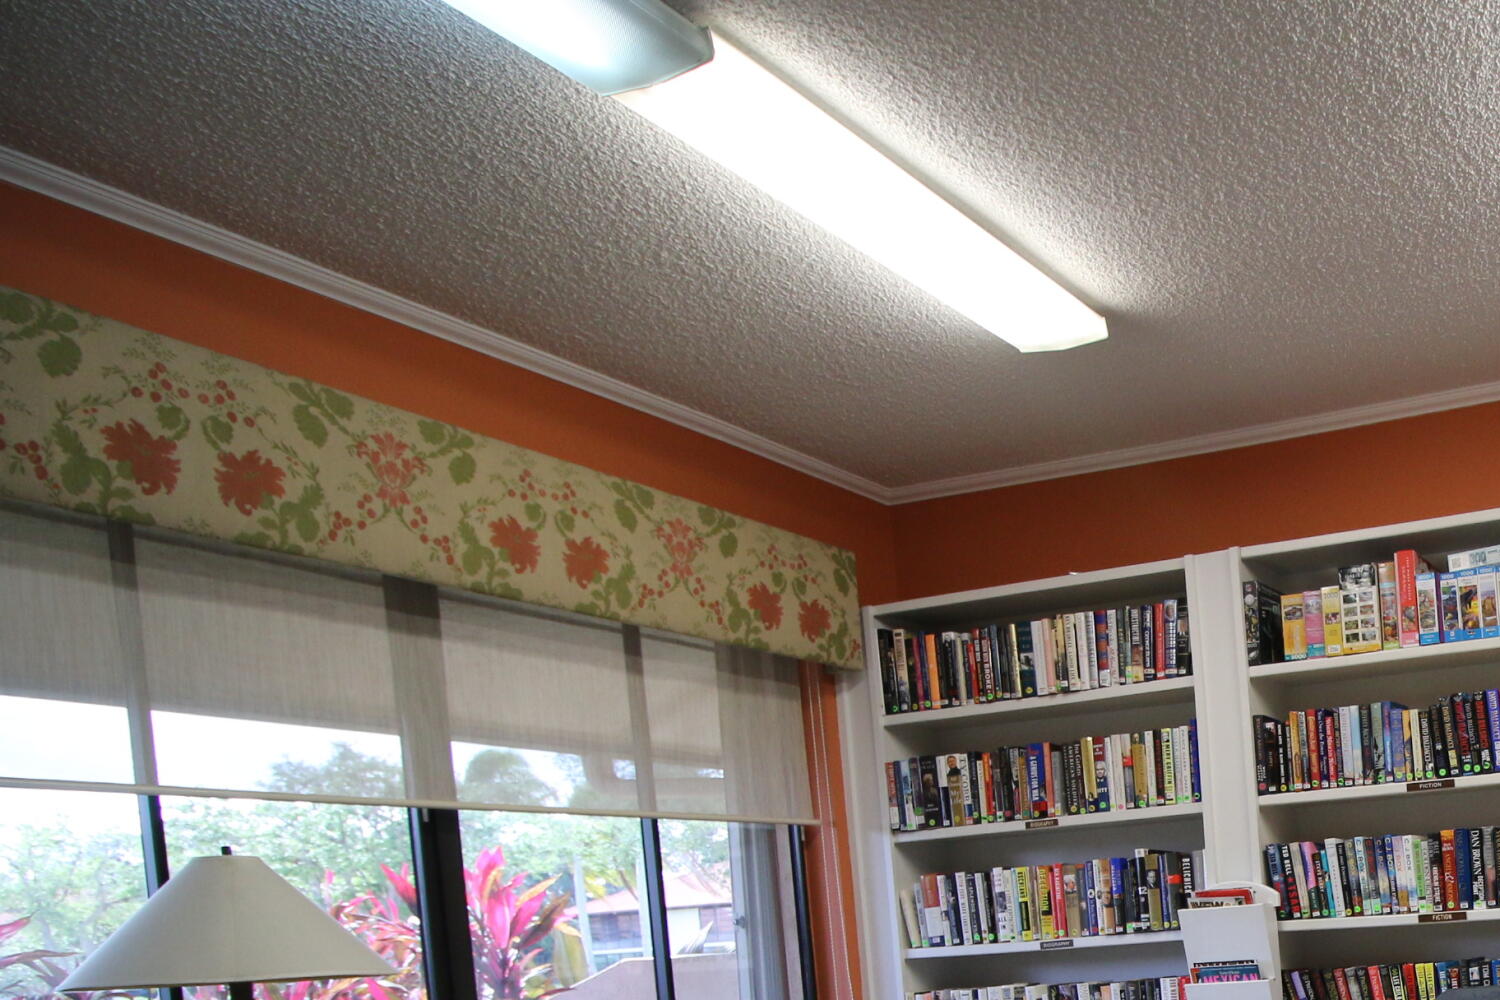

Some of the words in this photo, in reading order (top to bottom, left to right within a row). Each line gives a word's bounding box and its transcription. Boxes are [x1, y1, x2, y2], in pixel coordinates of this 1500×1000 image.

[1488, 691, 1498, 709] DAVID
[1491, 711, 1500, 739] BALDACCI
[1471, 831, 1479, 846] DAN
[1473, 849, 1482, 874] BROWN
[1182, 858, 1191, 894] BELICHICK
